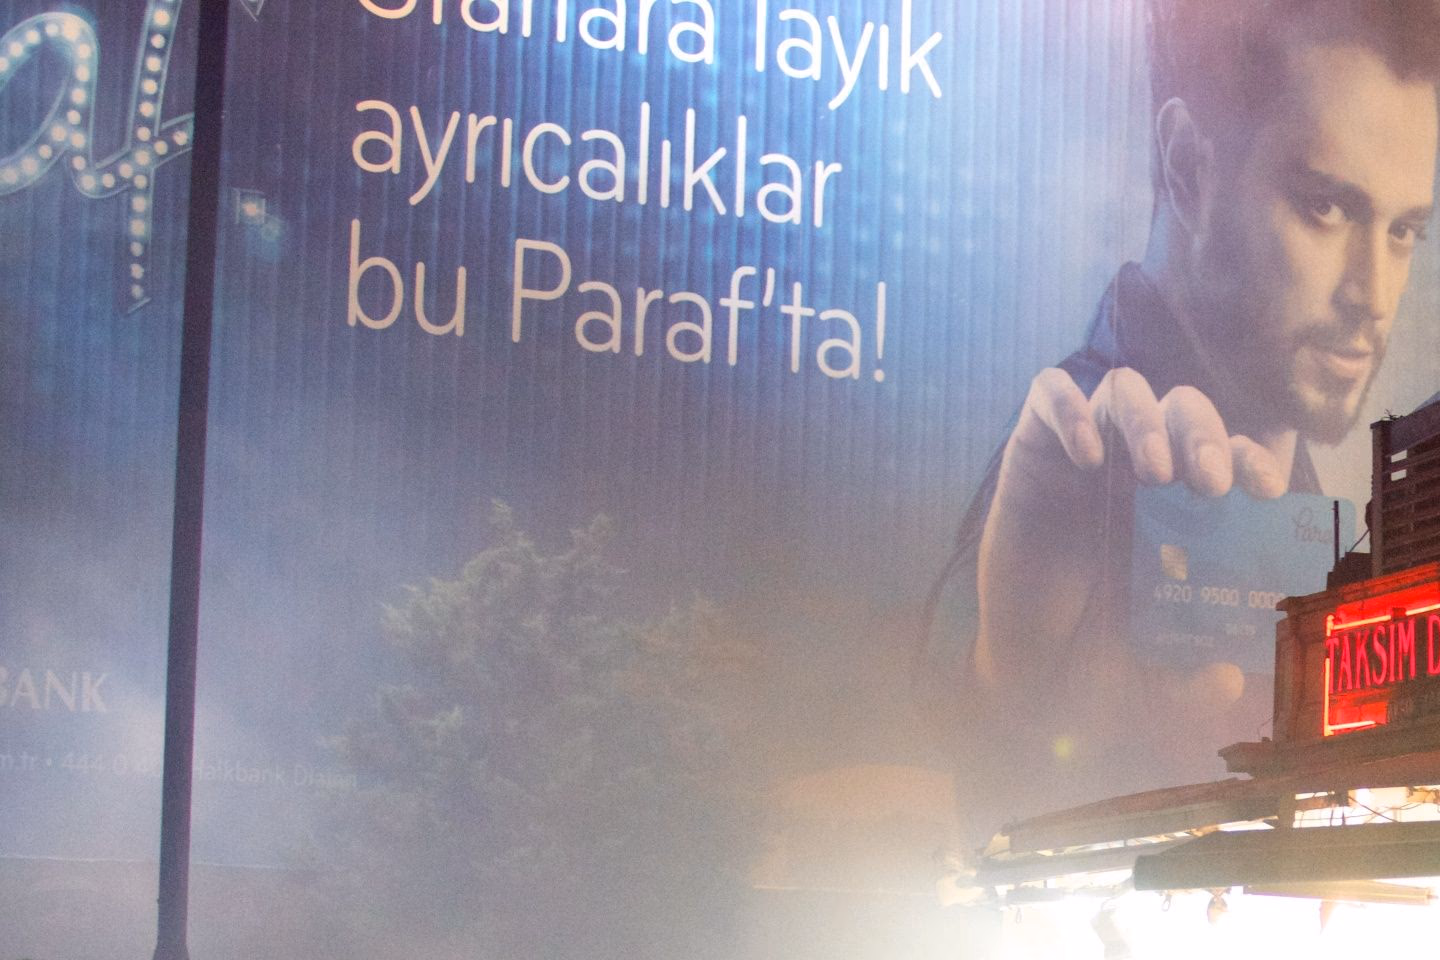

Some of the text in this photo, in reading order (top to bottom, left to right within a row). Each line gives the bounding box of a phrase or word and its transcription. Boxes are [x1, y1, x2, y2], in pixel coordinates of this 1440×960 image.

[754, 0, 944, 110] layık
[351, 100, 843, 228] ayrıcalıklar
[348, 218, 888, 382] bu Paraf'ta!
